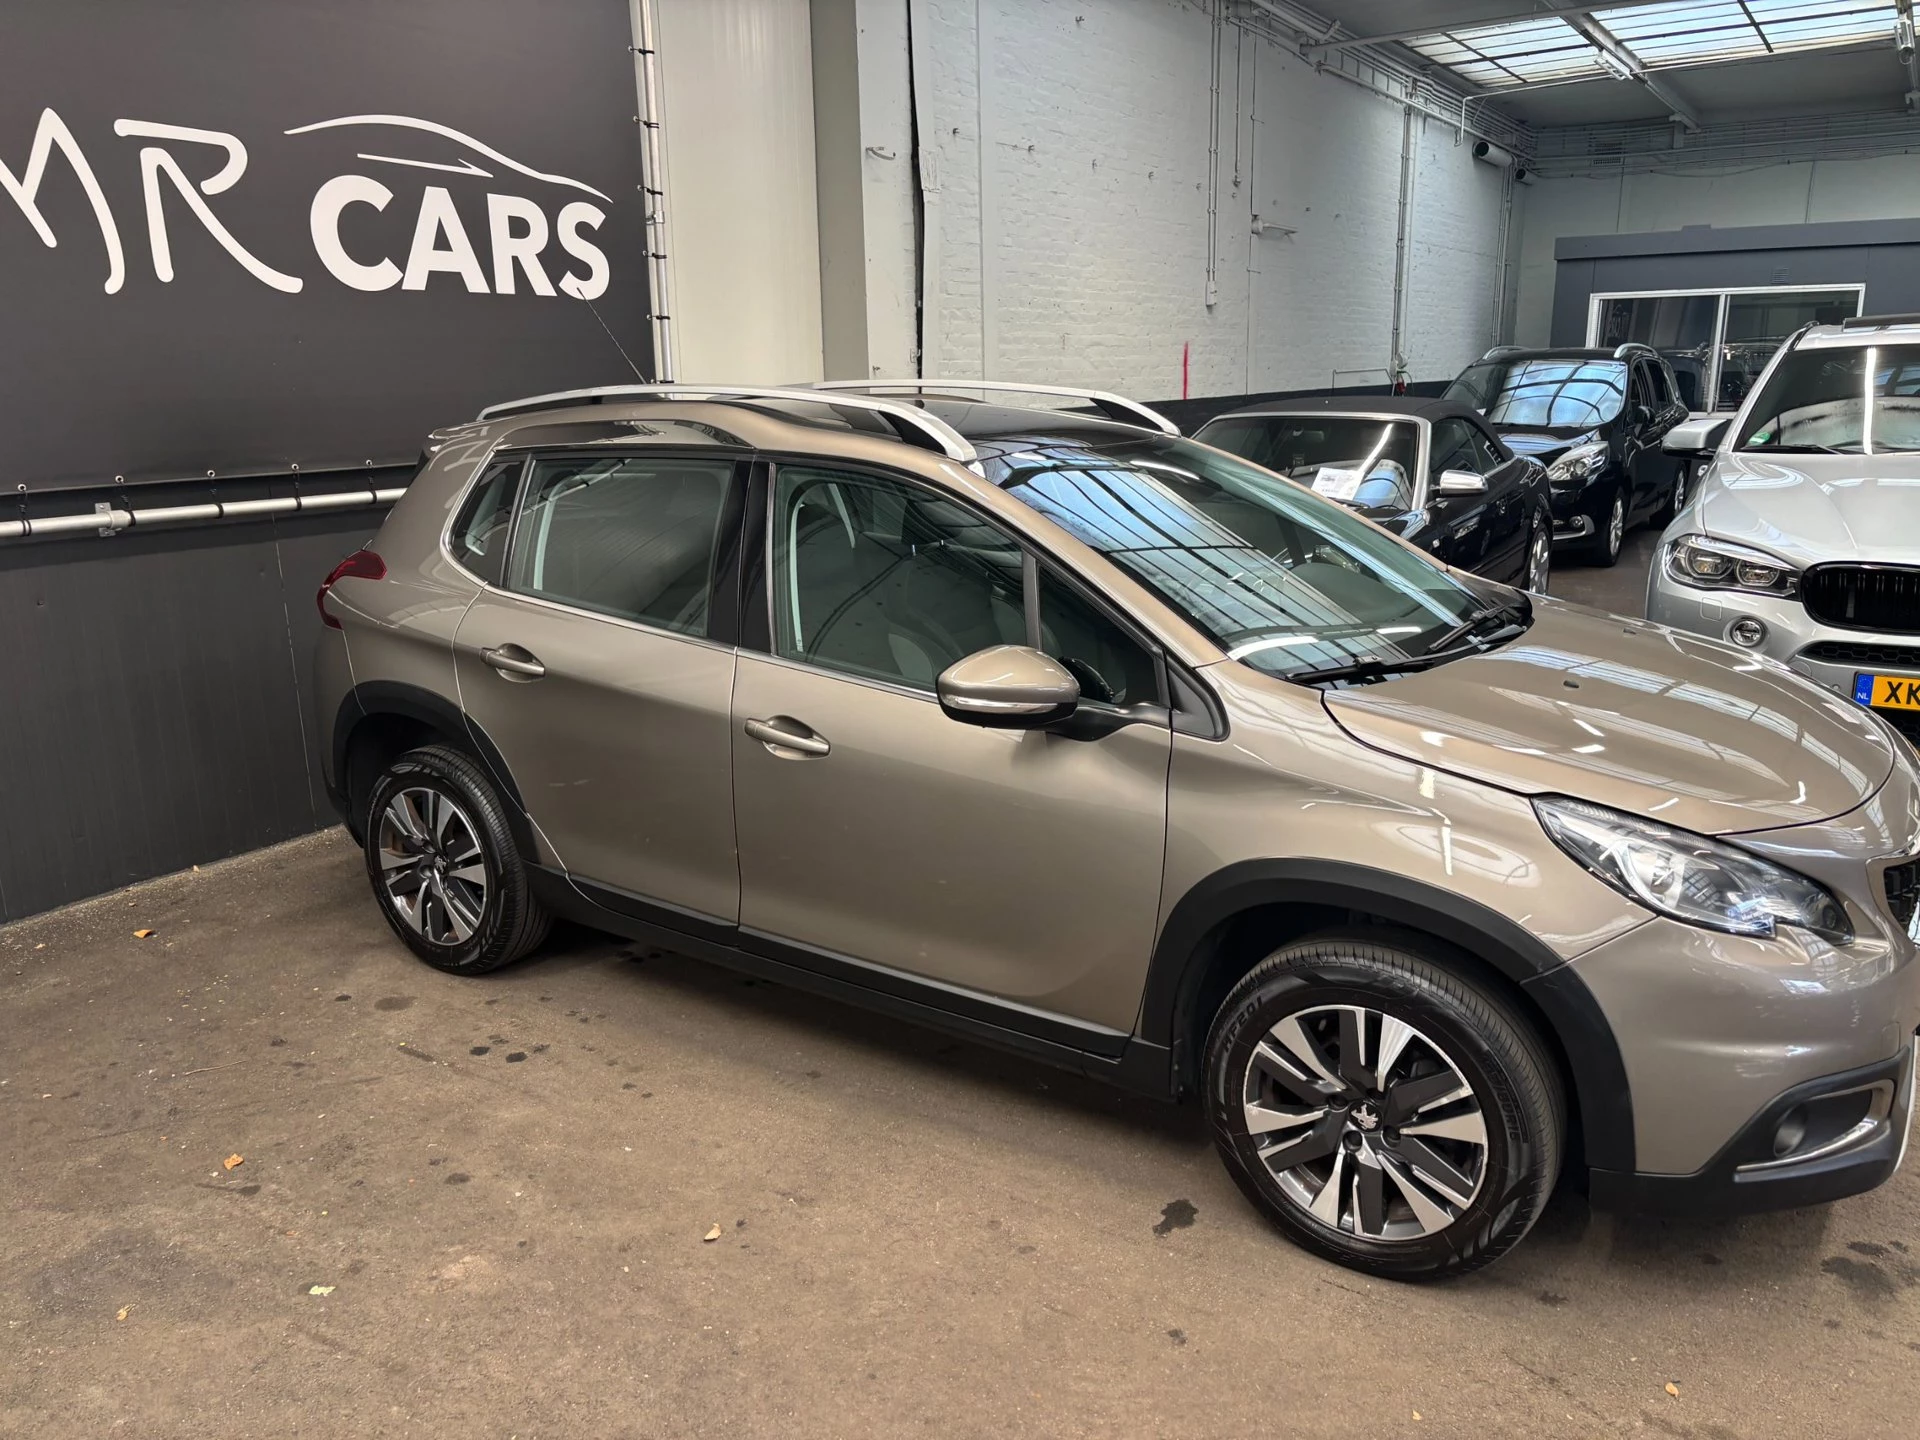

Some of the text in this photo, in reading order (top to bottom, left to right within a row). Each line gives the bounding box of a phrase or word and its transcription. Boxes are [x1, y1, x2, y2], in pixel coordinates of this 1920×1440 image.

[310, 174, 610, 300] CARS
[1857, 692, 1869, 700] NL
[1884, 681, 1920, 705] XK
